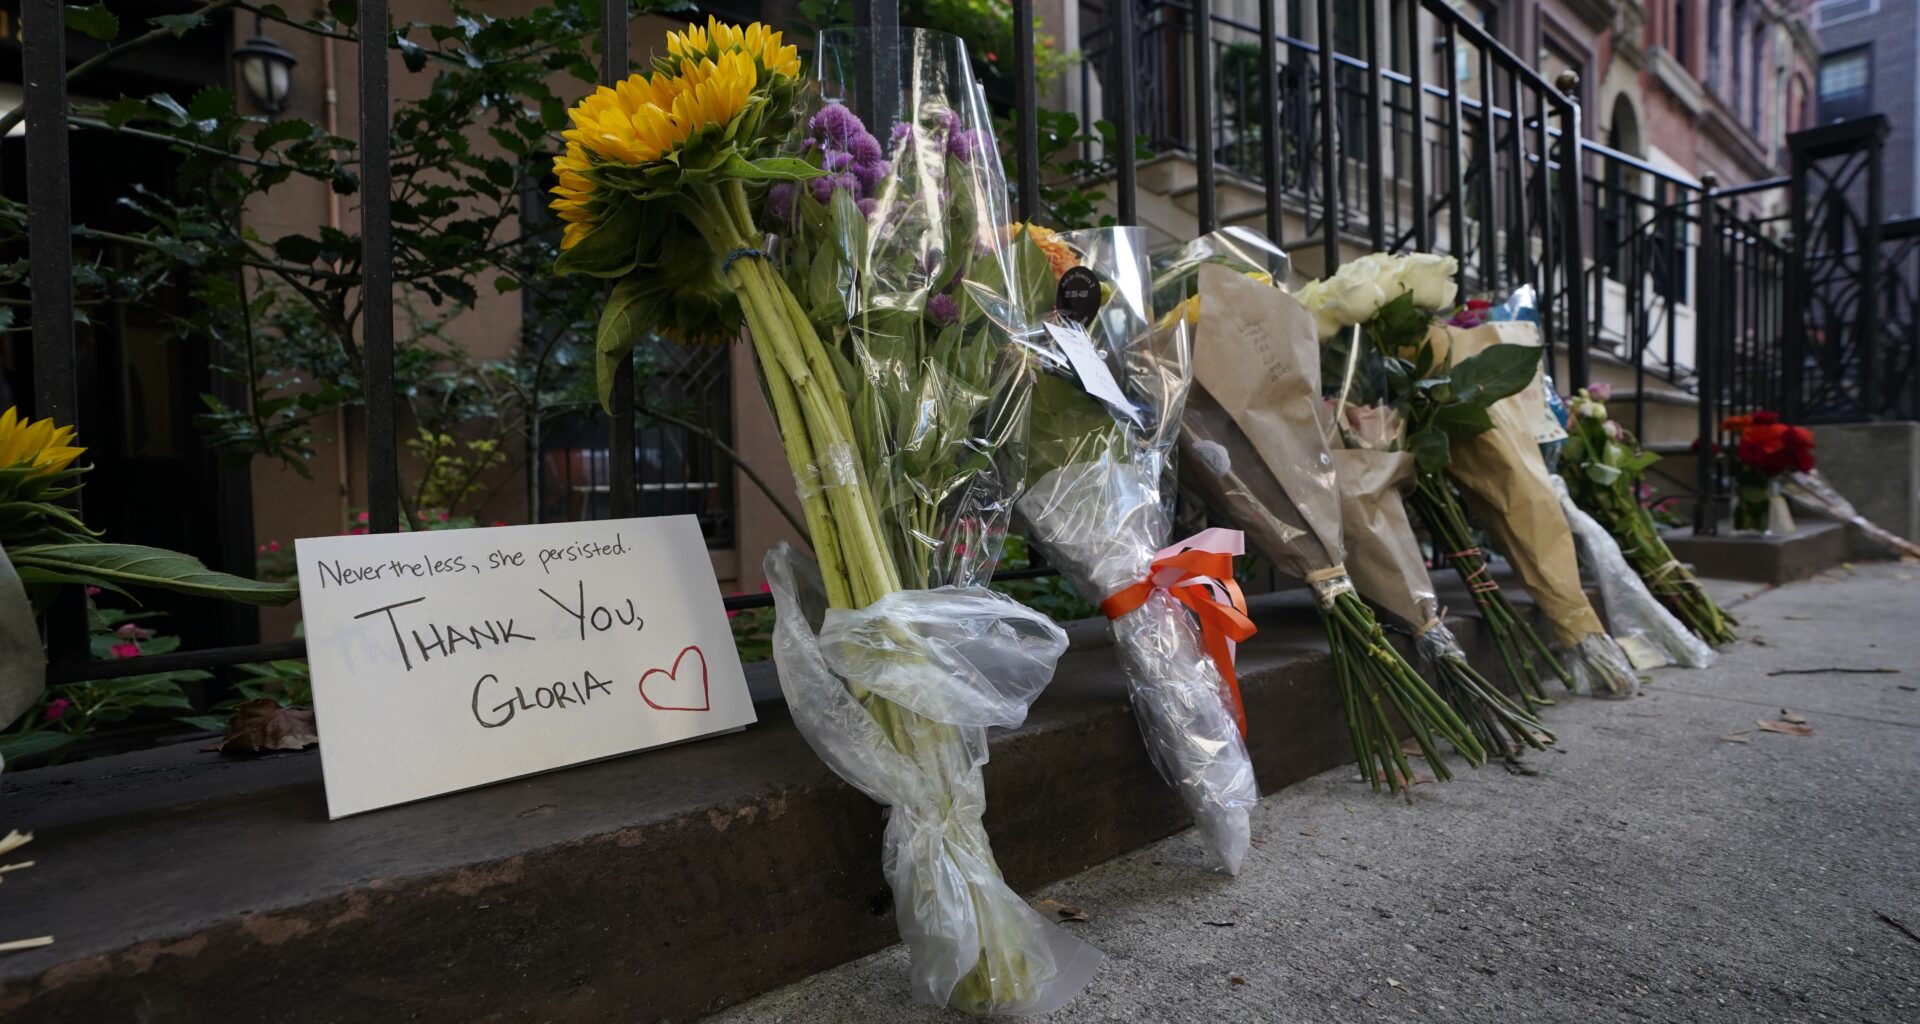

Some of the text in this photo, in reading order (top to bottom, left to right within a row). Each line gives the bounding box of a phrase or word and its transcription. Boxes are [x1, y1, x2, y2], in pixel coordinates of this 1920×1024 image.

[317, 532, 633, 589] Nevertheless, she persisted.
[353, 596, 537, 672] THANK
[471, 670, 614, 729] GLORIA
